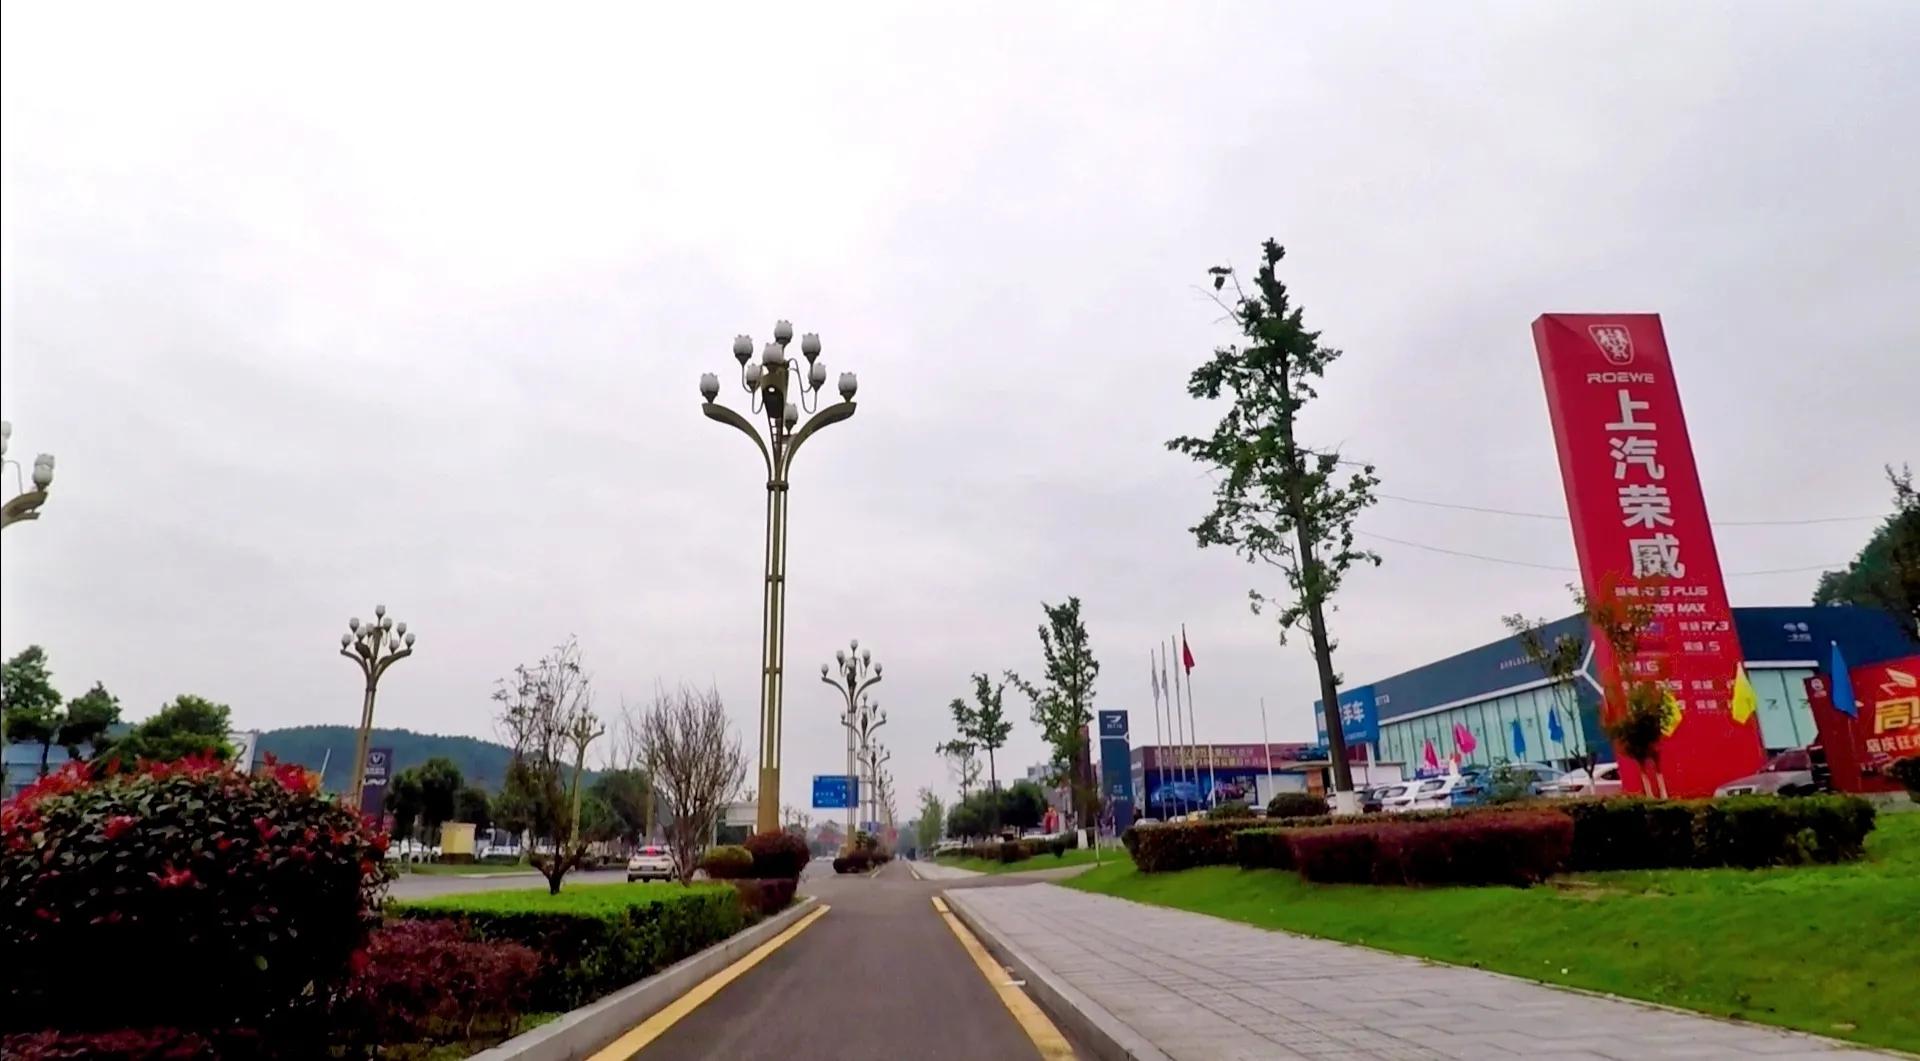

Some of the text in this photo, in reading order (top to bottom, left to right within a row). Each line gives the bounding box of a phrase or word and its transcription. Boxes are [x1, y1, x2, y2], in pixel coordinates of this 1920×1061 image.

[1587, 372, 1655, 384] ROEWE
[1605, 389, 1685, 579] 上汽荣威
[1672, 586, 1708, 596] PLUS
[1677, 603, 1706, 613] MAX
